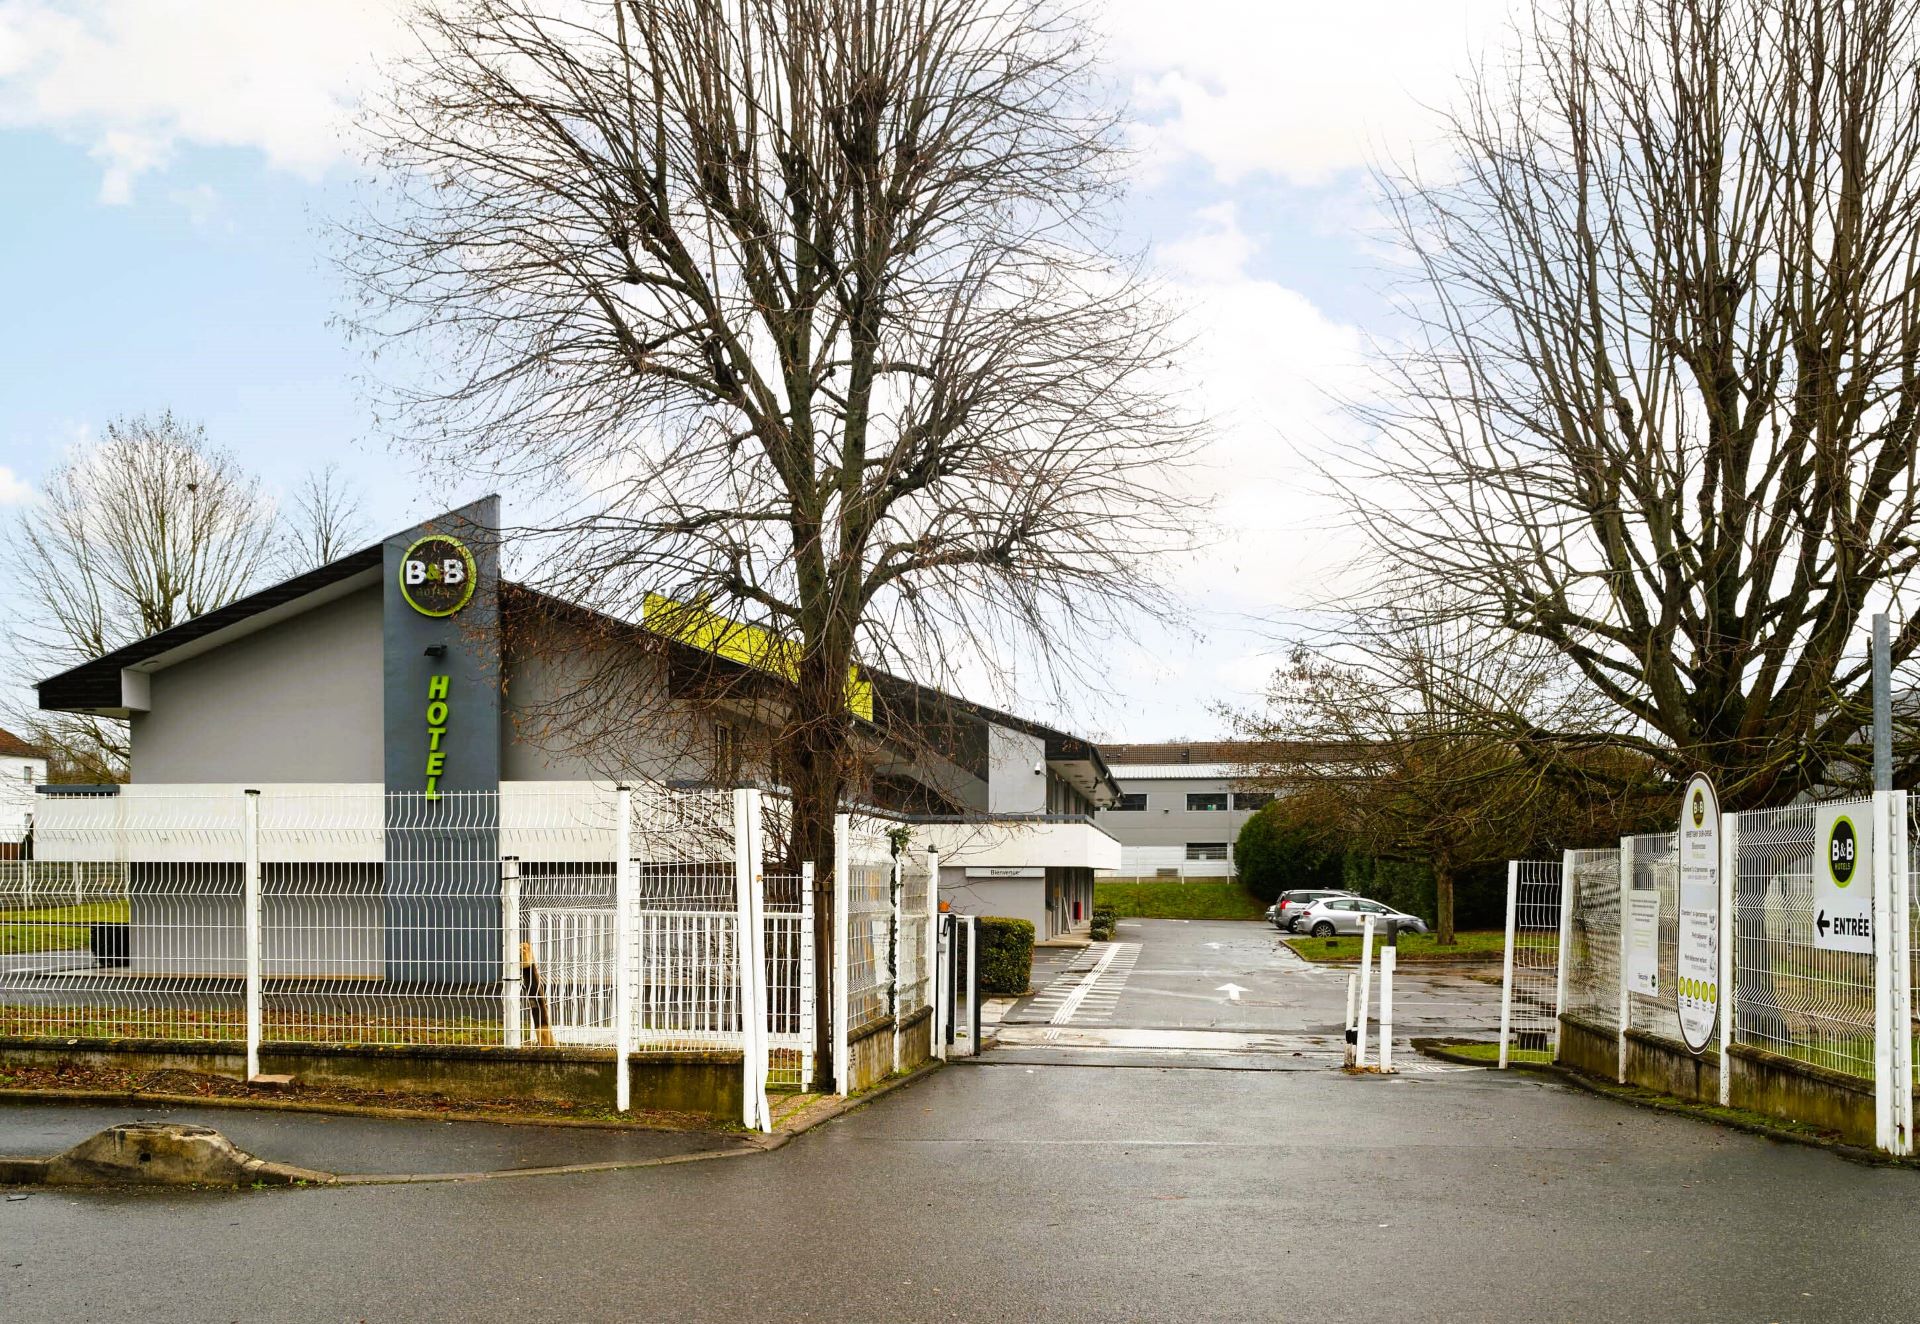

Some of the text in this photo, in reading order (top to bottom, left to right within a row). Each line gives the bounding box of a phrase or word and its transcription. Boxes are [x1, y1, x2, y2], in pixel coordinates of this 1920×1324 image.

[406, 559, 464, 584] B&B
[425, 675, 449, 800] HOTEL
[1832, 838, 1854, 861] B&B
[1834, 862, 1851, 871] HOTELS
[1833, 912, 1870, 937] ENTRÉE
